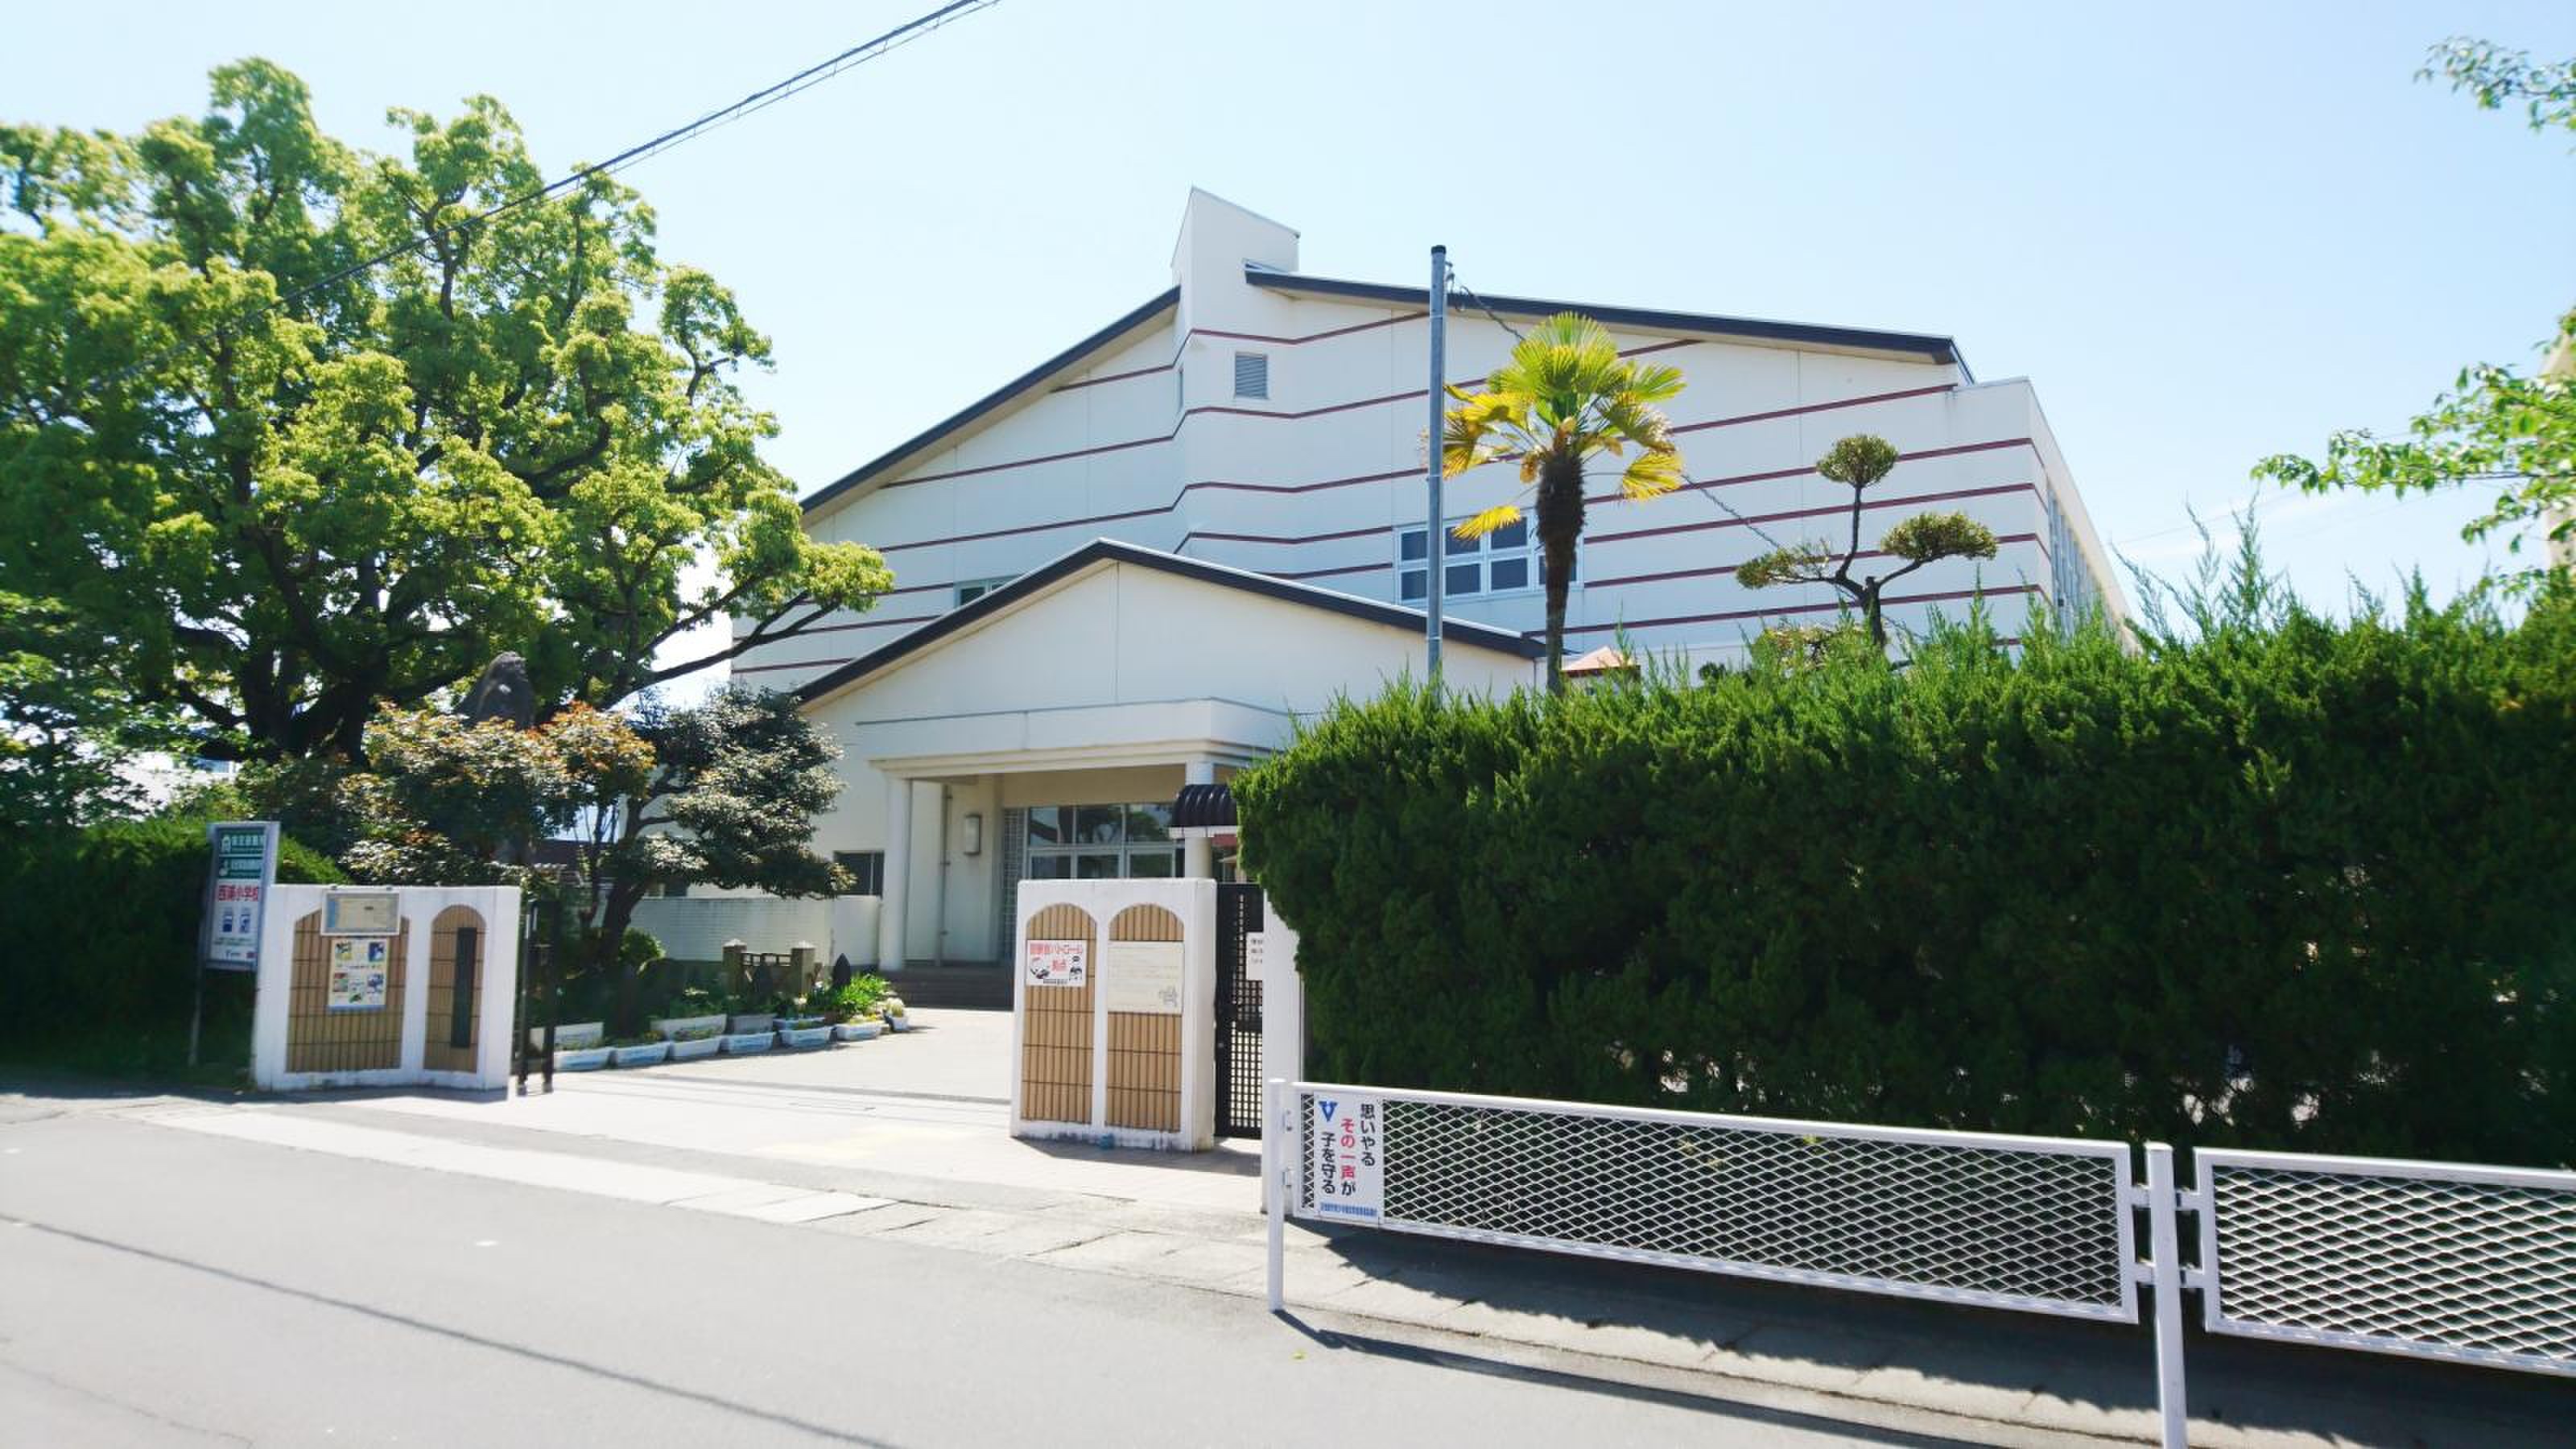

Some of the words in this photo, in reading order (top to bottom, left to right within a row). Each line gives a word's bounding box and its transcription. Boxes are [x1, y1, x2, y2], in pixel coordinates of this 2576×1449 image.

[1321, 1131, 1337, 1195] 子を守る
[1340, 1117, 1356, 1196] その一声が
[1360, 1103, 1376, 1167] 思いやる
